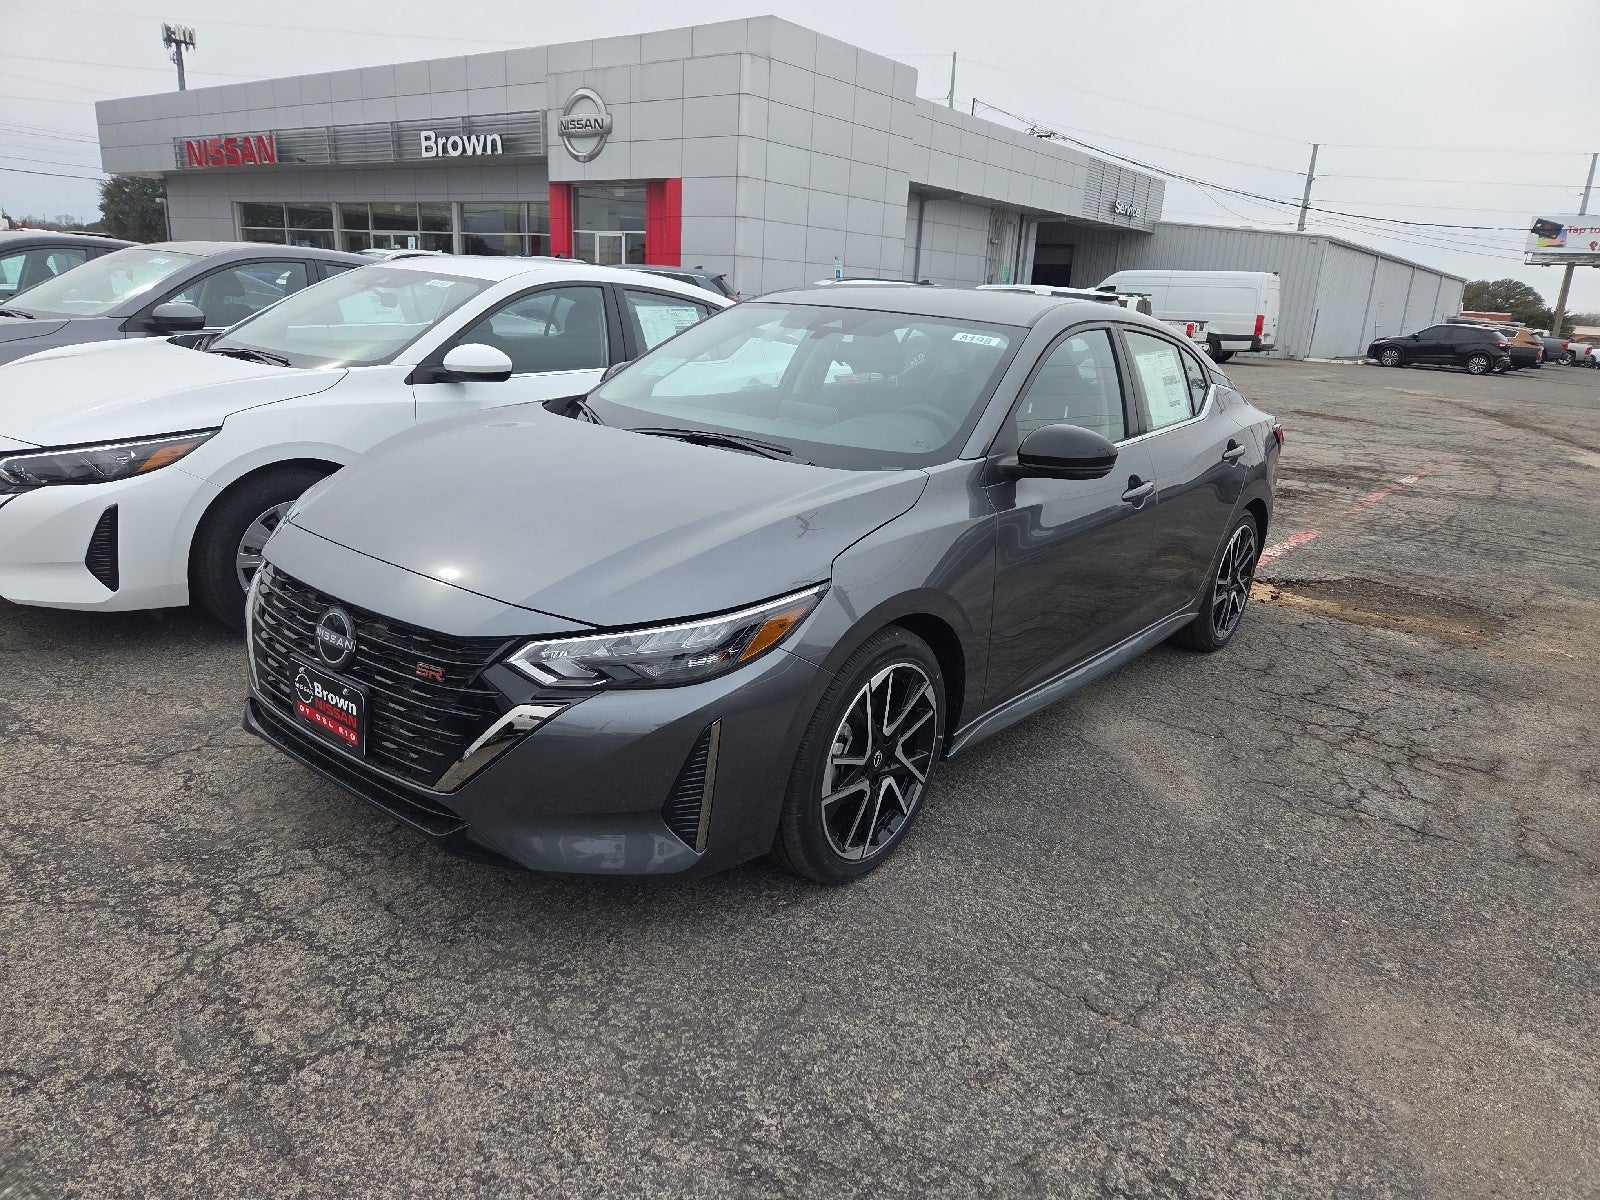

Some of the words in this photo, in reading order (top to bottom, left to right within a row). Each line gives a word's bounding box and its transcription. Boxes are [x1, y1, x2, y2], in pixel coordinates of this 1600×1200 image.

[560, 117, 604, 131] NISSAN
[186, 134, 278, 167] NISSAN
[420, 130, 503, 158] Brown
[1115, 200, 1140, 217] Service
[1568, 225, 1586, 235] Tap
[315, 626, 355, 651] NISSAN
[415, 661, 445, 682] SR
[313, 682, 357, 716] Brown
[299, 704, 311, 715] OF
[315, 713, 334, 729] DEL
[338, 726, 357, 742] RIO
[314, 697, 357, 729] NISSAN
